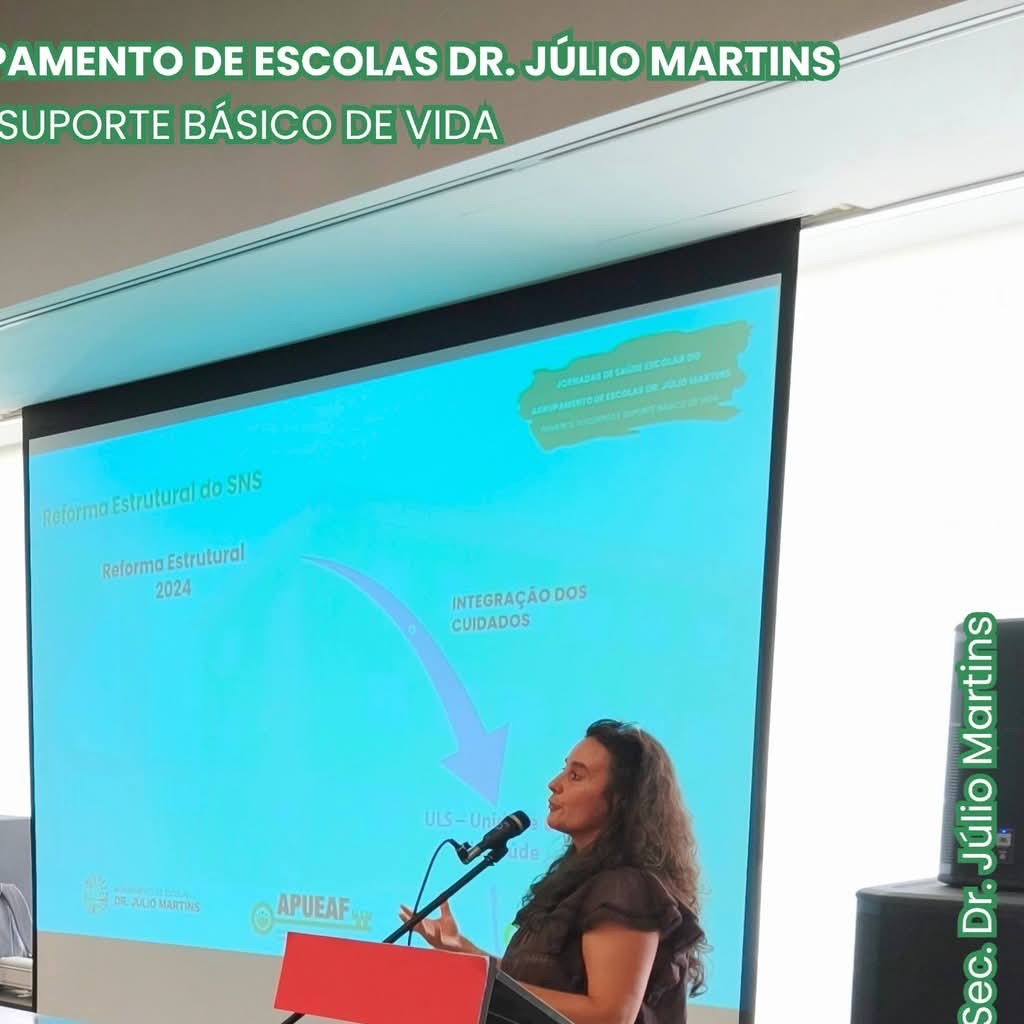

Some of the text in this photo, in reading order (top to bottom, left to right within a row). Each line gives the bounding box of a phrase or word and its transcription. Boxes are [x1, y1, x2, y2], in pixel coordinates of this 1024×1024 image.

[42, 470, 262, 527] Reforma Estrutural do SNS
[103, 543, 245, 579] Reforma Estrutural
[155, 579, 191, 599] 2024
[452, 585, 587, 610] INTEGRAÇÃO DOS
[452, 614, 530, 632] CUIDADOS
[425, 810, 452, 827] ULS
[277, 893, 350, 920] APUEAF
